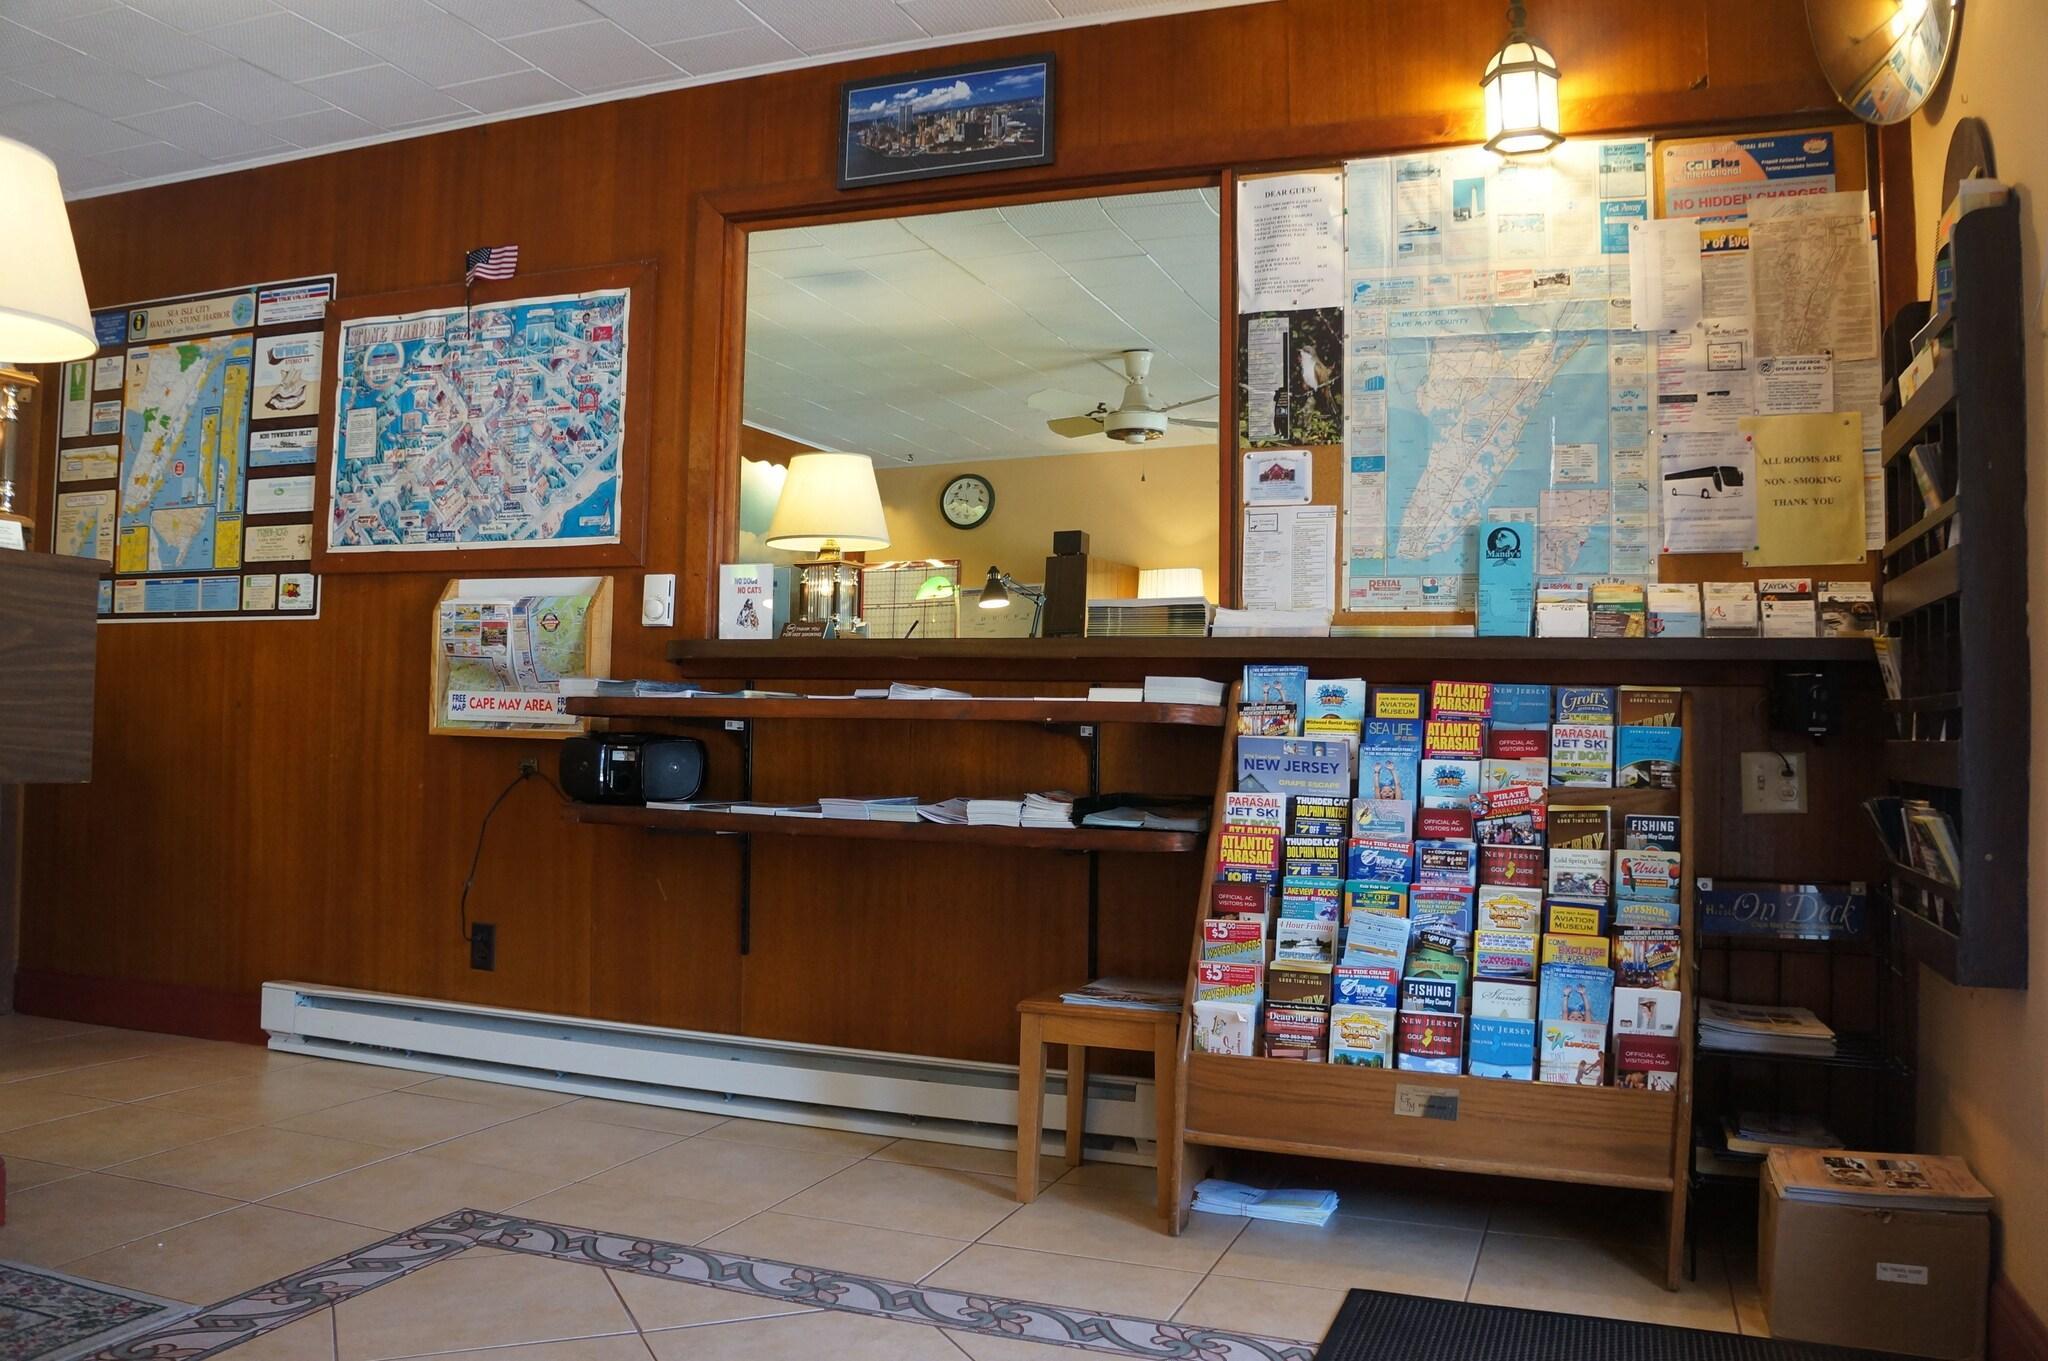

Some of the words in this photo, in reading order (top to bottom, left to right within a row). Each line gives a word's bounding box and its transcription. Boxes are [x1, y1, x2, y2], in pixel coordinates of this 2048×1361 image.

[1265, 190, 1287, 198] DEAR
[1289, 186, 1318, 195] GUEST
[1673, 198, 1694, 210] NO
[1698, 194, 1752, 208] HIDDEN
[180, 307, 194, 315] ISLE
[195, 304, 210, 314] CITY
[1402, 310, 1441, 318] WELCOME
[179, 314, 200, 324] STONE
[202, 310, 230, 321] HARBOR
[349, 327, 388, 346] STONE
[395, 320, 444, 340] HARBOR
[1762, 456, 1780, 465] ALL
[1784, 455, 1820, 464] ROOMS
[1823, 454, 1842, 463] ARE
[1764, 478, 1786, 486] NON
[1793, 476, 1842, 485] SMOKING
[1772, 498, 1809, 507] THANK
[1813, 497, 1834, 506] YOU
[1486, 550, 1522, 559] Mandy's
[737, 586, 746, 594] NO
[747, 586, 762, 594] CATS
[1368, 579, 1402, 591] RENTAL
[1434, 682, 1486, 698] ATLANTIC
[1493, 686, 1512, 694] NEW
[1516, 687, 1546, 695] JERSEY
[452, 694, 466, 702] FREE
[469, 696, 495, 710] CAPE
[498, 698, 522, 711] MAY
[524, 698, 553, 712] AREA
[1562, 690, 1609, 712] Groff's
[452, 704, 466, 712] MAP
[1432, 698, 1484, 712] PARASAIL
[1369, 722, 1390, 735] SEA
[1392, 724, 1412, 736] LIFE
[1427, 722, 1480, 737] ATLANTIC
[1554, 728, 1609, 739] PARASAIL
[1426, 736, 1479, 750] PARASAIL
[1554, 739, 1580, 748] JET
[1584, 740, 1608, 749] SKI
[1554, 750, 1576, 760] JET
[1578, 750, 1608, 762] BOAT
[1244, 758, 1280, 771] NEW
[1284, 760, 1340, 774] JERSEY
[1296, 796, 1332, 806] THUNDER
[1334, 798, 1350, 806] CAT
[1492, 790, 1526, 800] PIRATE
[1228, 796, 1280, 808] PARASAIL
[1492, 797, 1530, 808] CRUISES
[1228, 807, 1252, 816] JET
[1256, 808, 1279, 818] SKI
[1296, 806, 1326, 818] DOLPHIN
[1326, 806, 1348, 818] WATCH
[1309, 826, 1320, 834] OFF
[1632, 820, 1674, 832] FISHING
[1221, 835, 1274, 851] ATLANTIC
[1286, 838, 1324, 846] THUNDER
[1220, 848, 1272, 864] PARASAIL
[1286, 846, 1316, 858] DOLPHIN
[1316, 847, 1338, 859] WATCH
[1507, 851, 1540, 861] JERSEY
[1242, 872, 1252, 882] OFF
[1300, 867, 1312, 875] OFF
[1318, 888, 1338, 896] DOCKS
[1623, 904, 1670, 917] OFFSHORE
[1733, 892, 1776, 922] On
[1786, 894, 1859, 934] Deck
[1554, 915, 1595, 924] AVIATION
[1286, 922, 1304, 930] Hour
[1305, 922, 1334, 932] Fishing
[1558, 946, 1606, 958] EXPLORE
[1201, 983, 1256, 1000] WAVERUNNERS
[1408, 984, 1452, 998] FISHING
[1424, 998, 1434, 1006] May
[1270, 1012, 1308, 1022] Deauville
[1310, 1015, 1324, 1024] Inn
[1402, 1016, 1421, 1025] NEW
[1426, 1018, 1458, 1028] JERSEY
[1472, 1023, 1494, 1032] NEW
[1498, 1024, 1531, 1036] JERSEY
[1625, 1050, 1655, 1058] OFFICIAL
